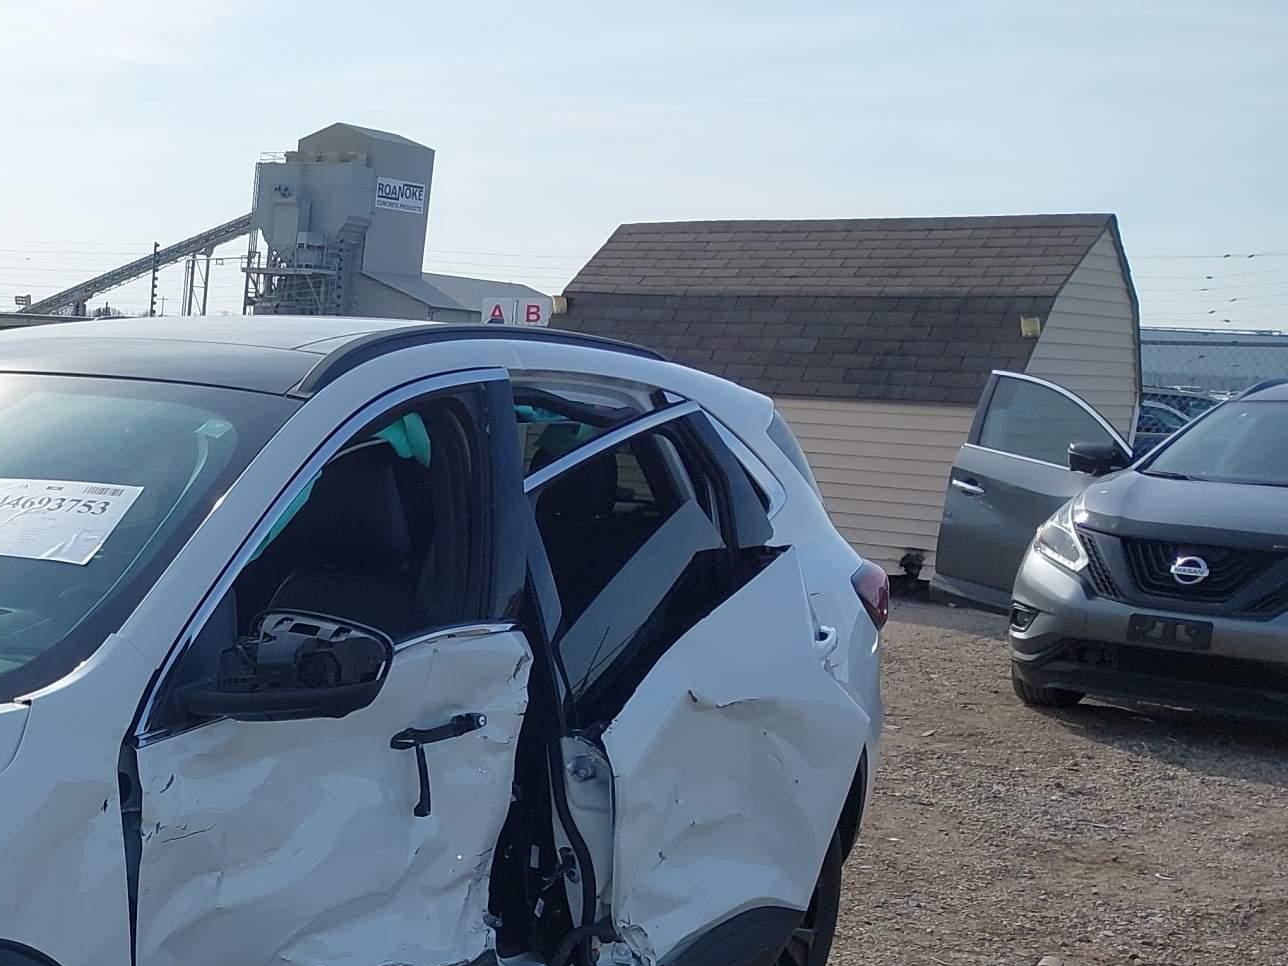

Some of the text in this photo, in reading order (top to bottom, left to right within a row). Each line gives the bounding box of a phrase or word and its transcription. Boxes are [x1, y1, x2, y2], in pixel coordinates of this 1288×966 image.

[377, 182, 423, 201] ROANOKE
[490, 304, 541, 323] A B
[1173, 567, 1204, 575] NISSAN
